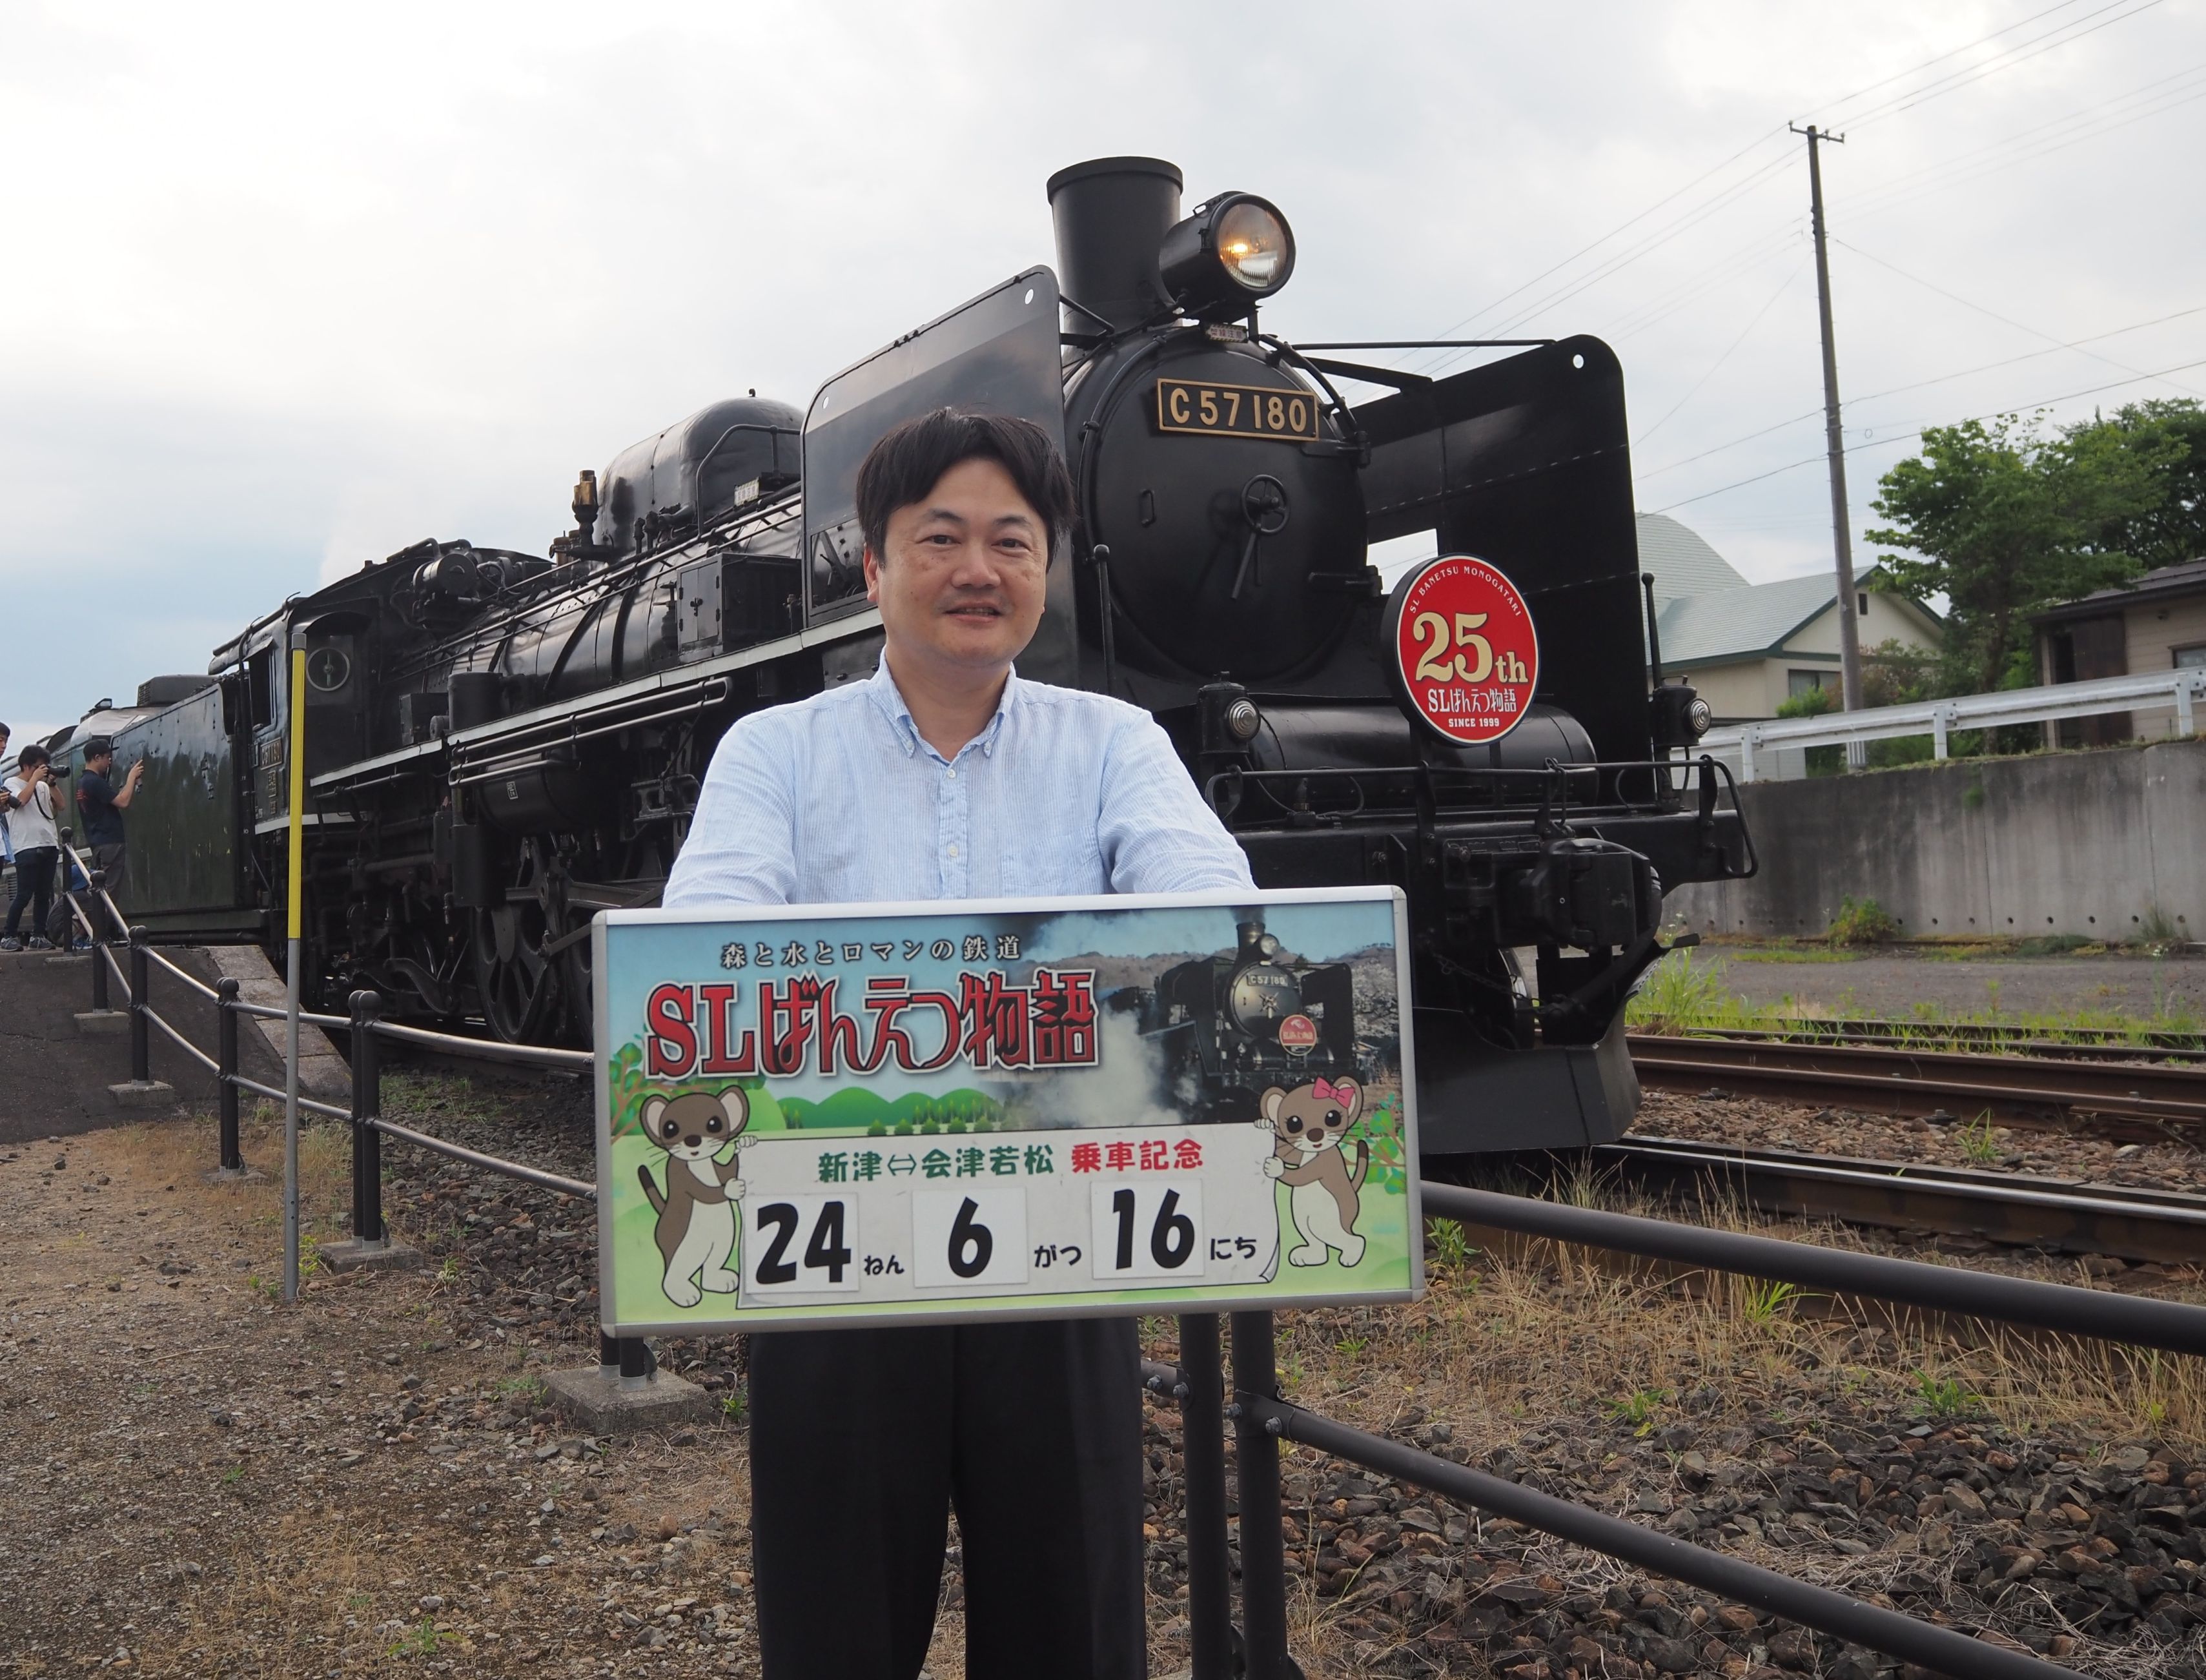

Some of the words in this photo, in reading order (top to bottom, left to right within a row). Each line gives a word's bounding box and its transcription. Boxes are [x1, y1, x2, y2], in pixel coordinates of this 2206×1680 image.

[1409, 599, 1420, 613] SL
[1418, 566, 1459, 596] BANETSU
[1464, 566, 1521, 617] MONOGATARI
[1428, 688, 1517, 713] SLばんえつ物語
[1448, 718, 1476, 728] SINCE
[1479, 717, 1500, 727] 1999
[720, 935, 1022, 968] 森と水とロマンの鉄道
[646, 967, 1100, 1081] SLばんえつ物語
[818, 1152, 883, 1183] 新津
[921, 1144, 1054, 1179] 会津若松
[1071, 1139, 1203, 1173] 乗車記念
[756, 1201, 852, 1285] 24
[863, 1255, 904, 1276] ねん
[948, 1196, 993, 1278] 6
[1034, 1244, 1082, 1269] がつ
[1112, 1189, 1195, 1270] 16
[1210, 1236, 1257, 1261] にち
